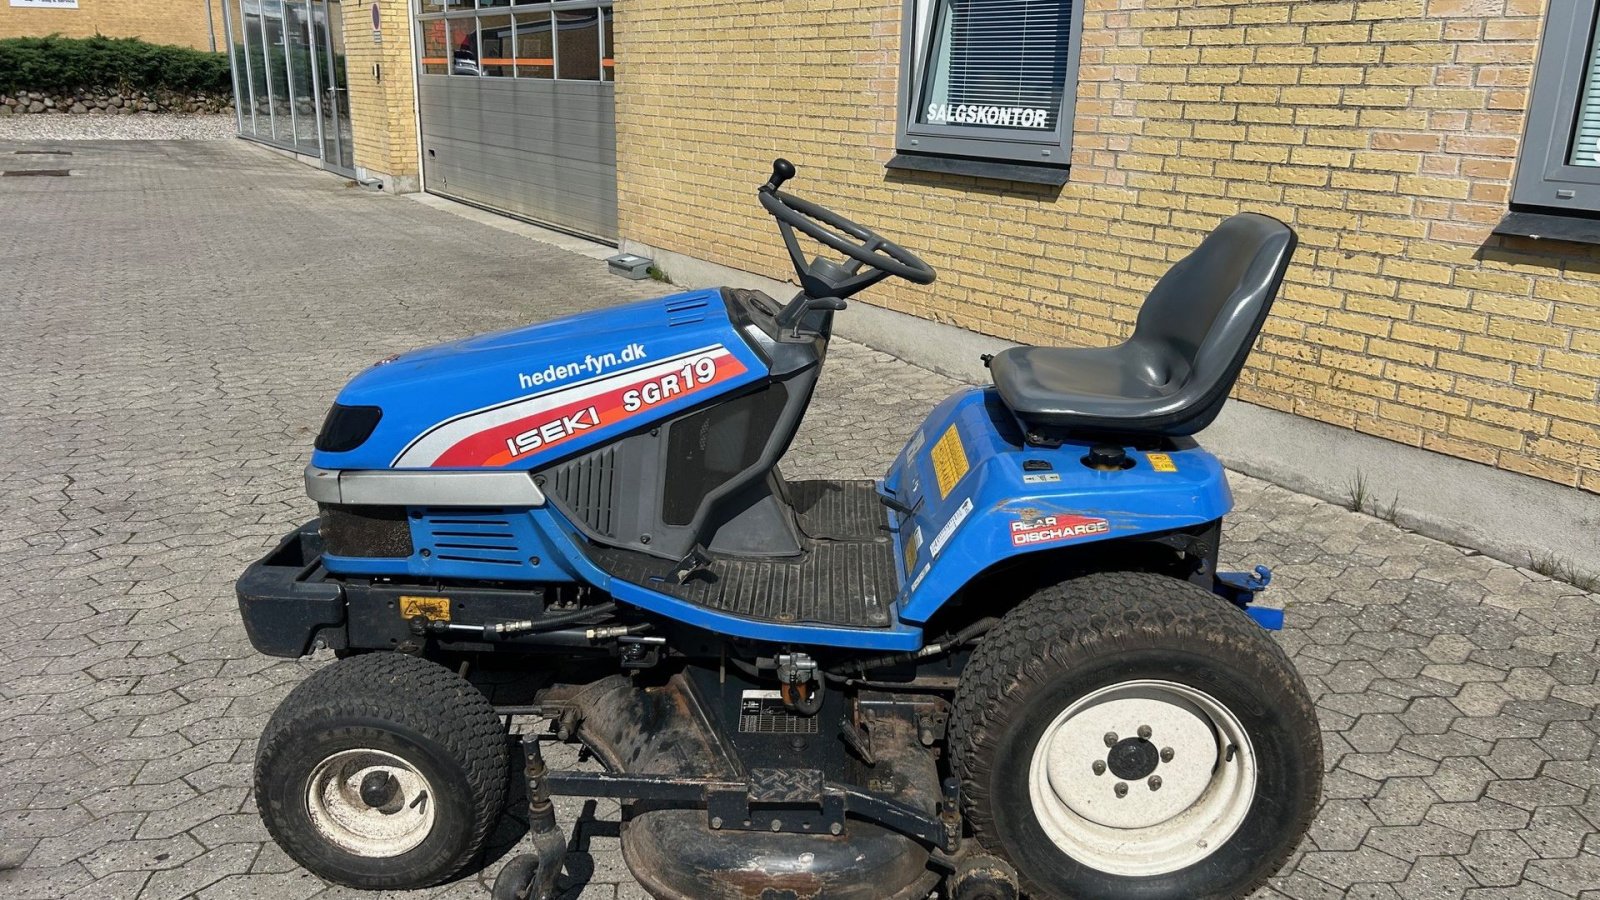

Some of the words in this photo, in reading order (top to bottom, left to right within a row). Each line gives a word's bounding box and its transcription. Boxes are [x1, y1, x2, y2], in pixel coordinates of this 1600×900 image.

[926, 103, 1047, 128] SALGSKONTOR
[518, 343, 647, 389] heden-fyn.dk
[506, 406, 601, 457] ISEKI
[1011, 517, 1057, 532] REAR
[1013, 521, 1108, 544] DISCHARGE
